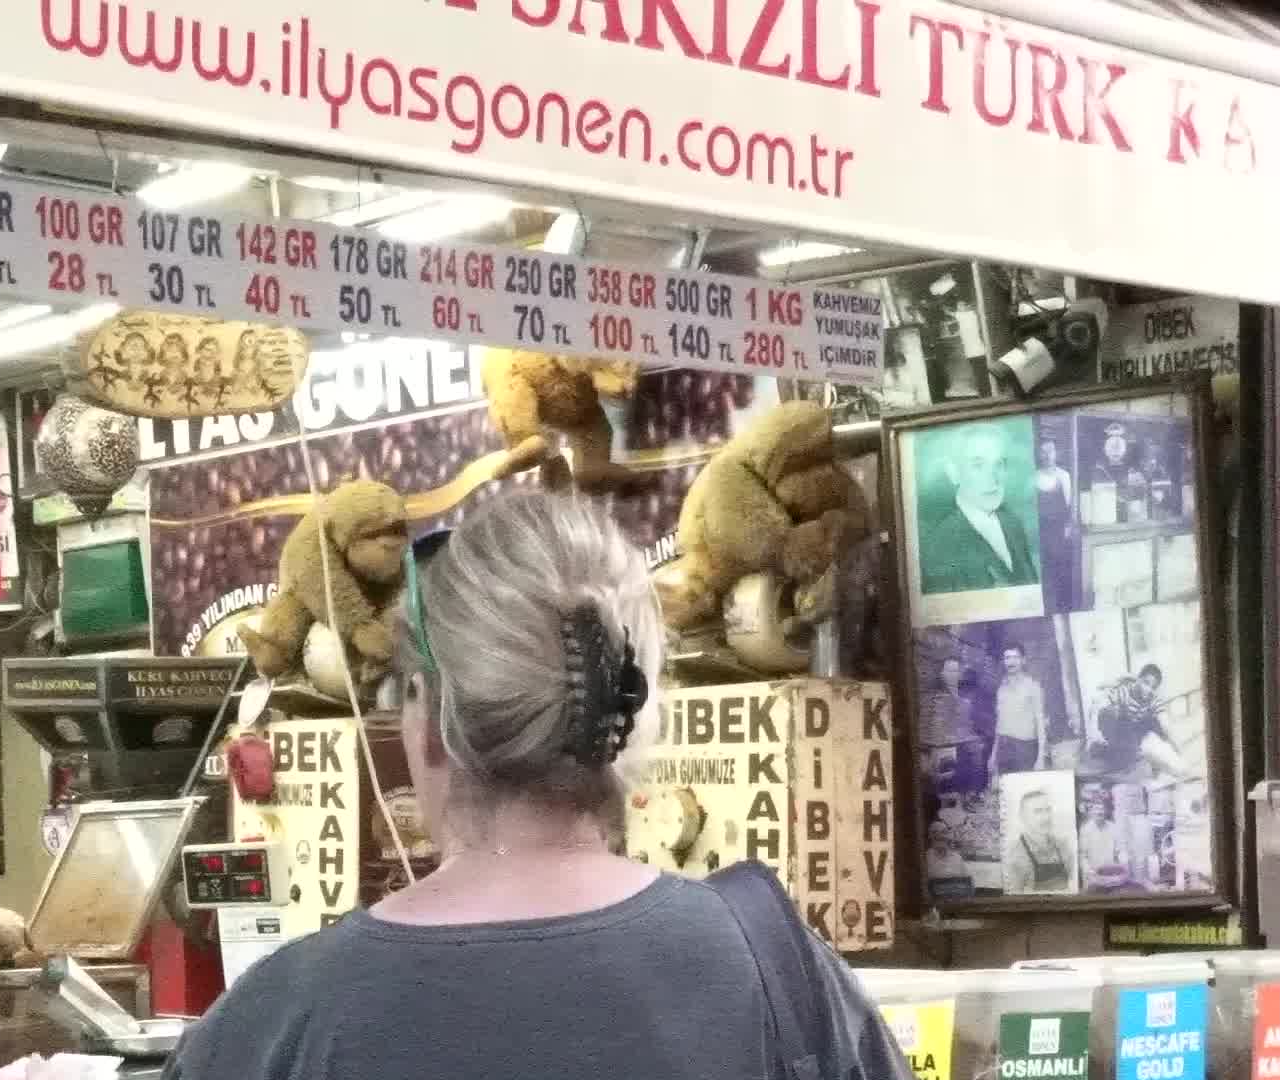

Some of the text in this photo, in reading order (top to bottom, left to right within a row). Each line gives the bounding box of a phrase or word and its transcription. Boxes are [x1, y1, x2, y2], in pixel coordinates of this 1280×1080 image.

[40, 0, 853, 198] www.ilyasgonen.com.tr
[909, 15, 1133, 153] TÜRK
[35, 197, 79, 241] 100
[88, 205, 124, 247] GR
[137, 211, 178, 254] 107
[188, 217, 223, 259] GR
[236, 223, 277, 265] 142
[284, 229, 318, 269] GR
[330, 235, 368, 276] 178
[377, 241, 409, 280] GR
[419, 247, 456, 284] 214
[464, 252, 495, 290] GR
[504, 257, 542, 296] 250
[548, 262, 577, 300] GR
[587, 267, 622, 305] 358
[628, 272, 657, 310] GR
[665, 278, 700, 315] 500
[705, 283, 733, 321] GR
[744, 287, 757, 321] 1
[767, 290, 803, 326] KG
[47, 251, 85, 293] 28
[96, 273, 119, 297] TL
[148, 263, 184, 304] 30
[195, 285, 216, 308] TL
[245, 274, 281, 315] 40
[290, 294, 312, 318] TL
[339, 285, 371, 324] 50
[381, 305, 401, 328] TL
[431, 295, 461, 332] 60
[466, 312, 484, 335] TL
[513, 304, 546, 343] 70
[552, 323, 571, 346] TL
[589, 313, 634, 354] 100
[640, 334, 659, 356] TL
[667, 323, 711, 361] 140
[717, 340, 735, 363] TL
[743, 333, 786, 369] 280
[791, 350, 809, 371] TL
[814, 317, 881, 341] YUMUŞAK
[273, 729, 344, 773] BEK
[1001, 1057, 1086, 1078] OSMANLI
[1121, 1031, 1201, 1058] NESCAFE
